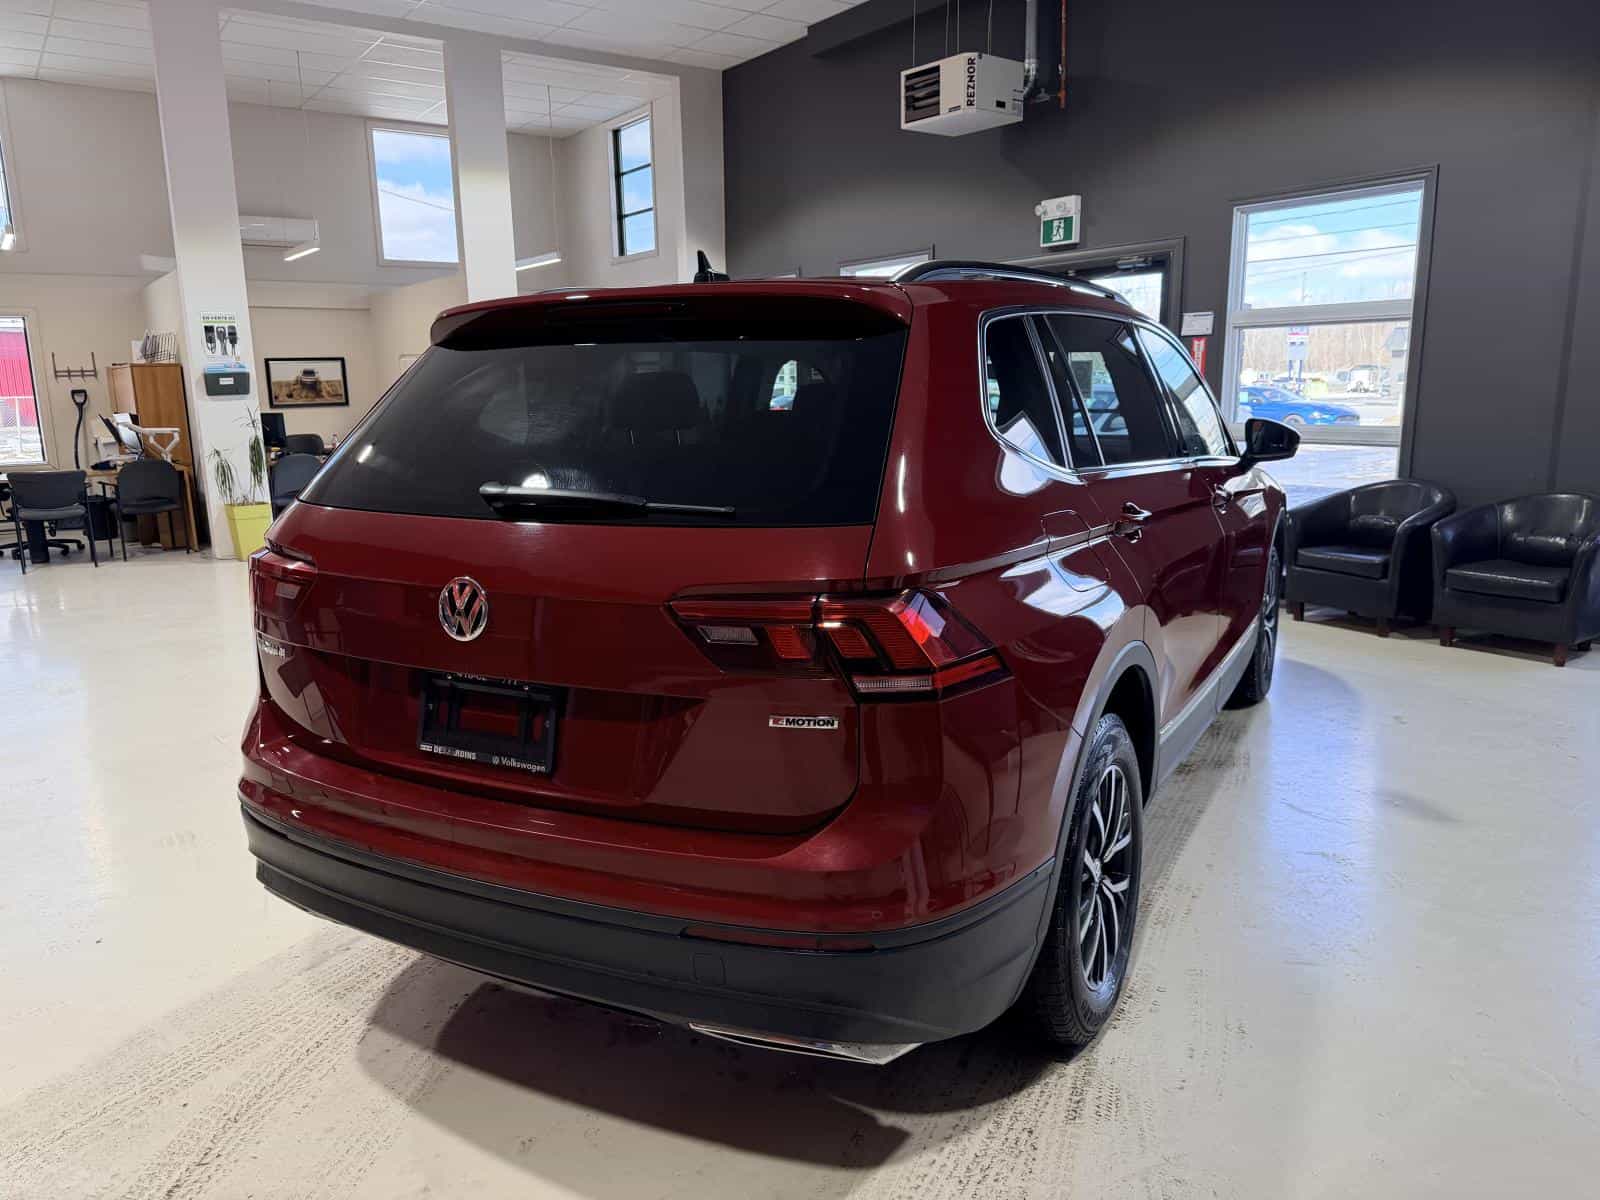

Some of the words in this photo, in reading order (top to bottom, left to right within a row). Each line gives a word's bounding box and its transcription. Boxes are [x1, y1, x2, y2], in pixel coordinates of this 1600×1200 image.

[966, 57, 976, 107] REZNOR
[433, 744, 477, 760] DERDINS
[501, 756, 546, 773] Volkswagen
